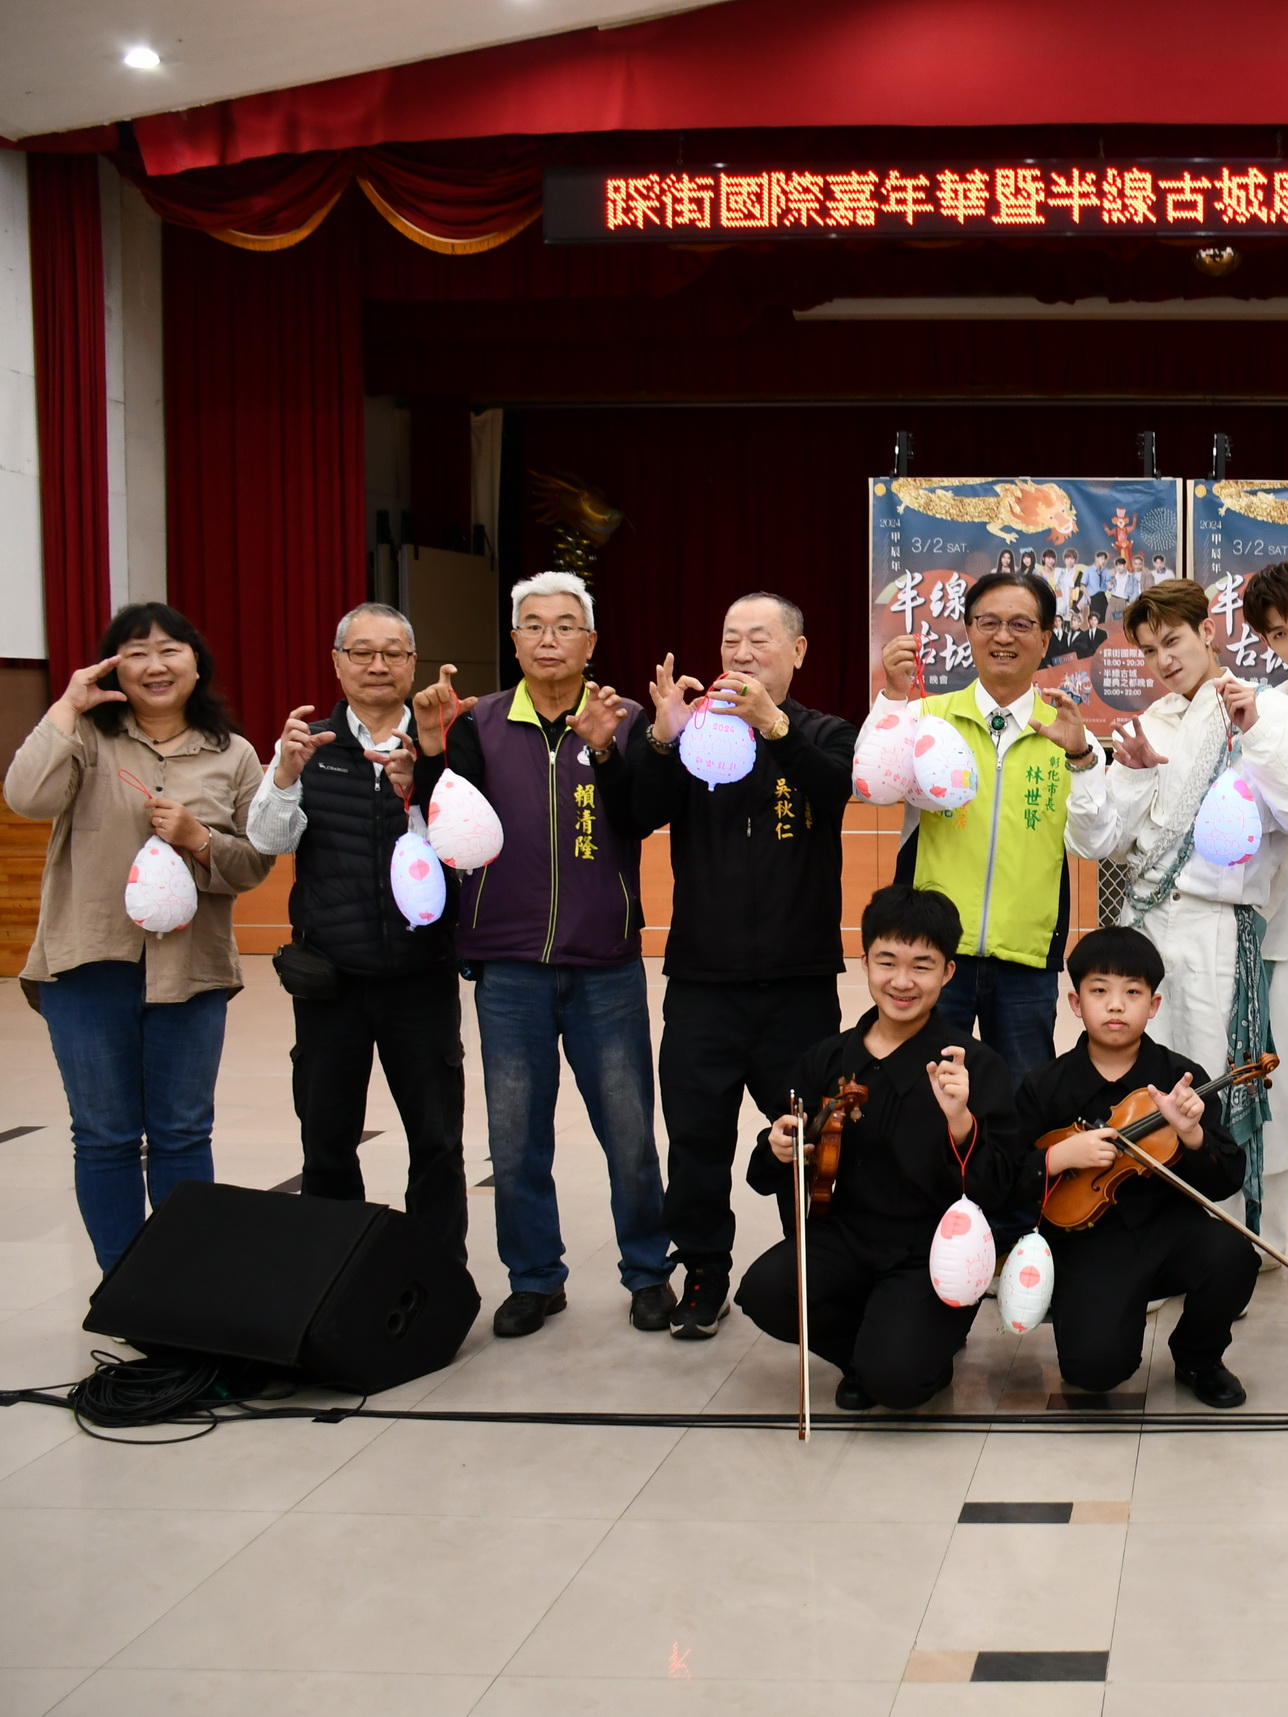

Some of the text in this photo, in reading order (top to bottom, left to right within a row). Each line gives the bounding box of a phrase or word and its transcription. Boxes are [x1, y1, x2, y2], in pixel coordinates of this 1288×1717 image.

[879, 518, 901, 528] 2024
[1199, 520, 1222, 529] 2024
[891, 531, 901, 572] 甲辰年
[911, 537, 970, 553] 3/2 SAT.
[1211, 533, 1221, 574] 甲辰年
[1232, 539, 1264, 555] 3/2
[890, 569, 967, 634] 半線
[1103, 688, 1120, 696] 20:00
[1024, 766, 1045, 831] 林世賢
[1045, 756, 1060, 812] 彰化市長
[573, 784, 598, 860] 賴清隆
[774, 778, 795, 840] 吳秋仁
